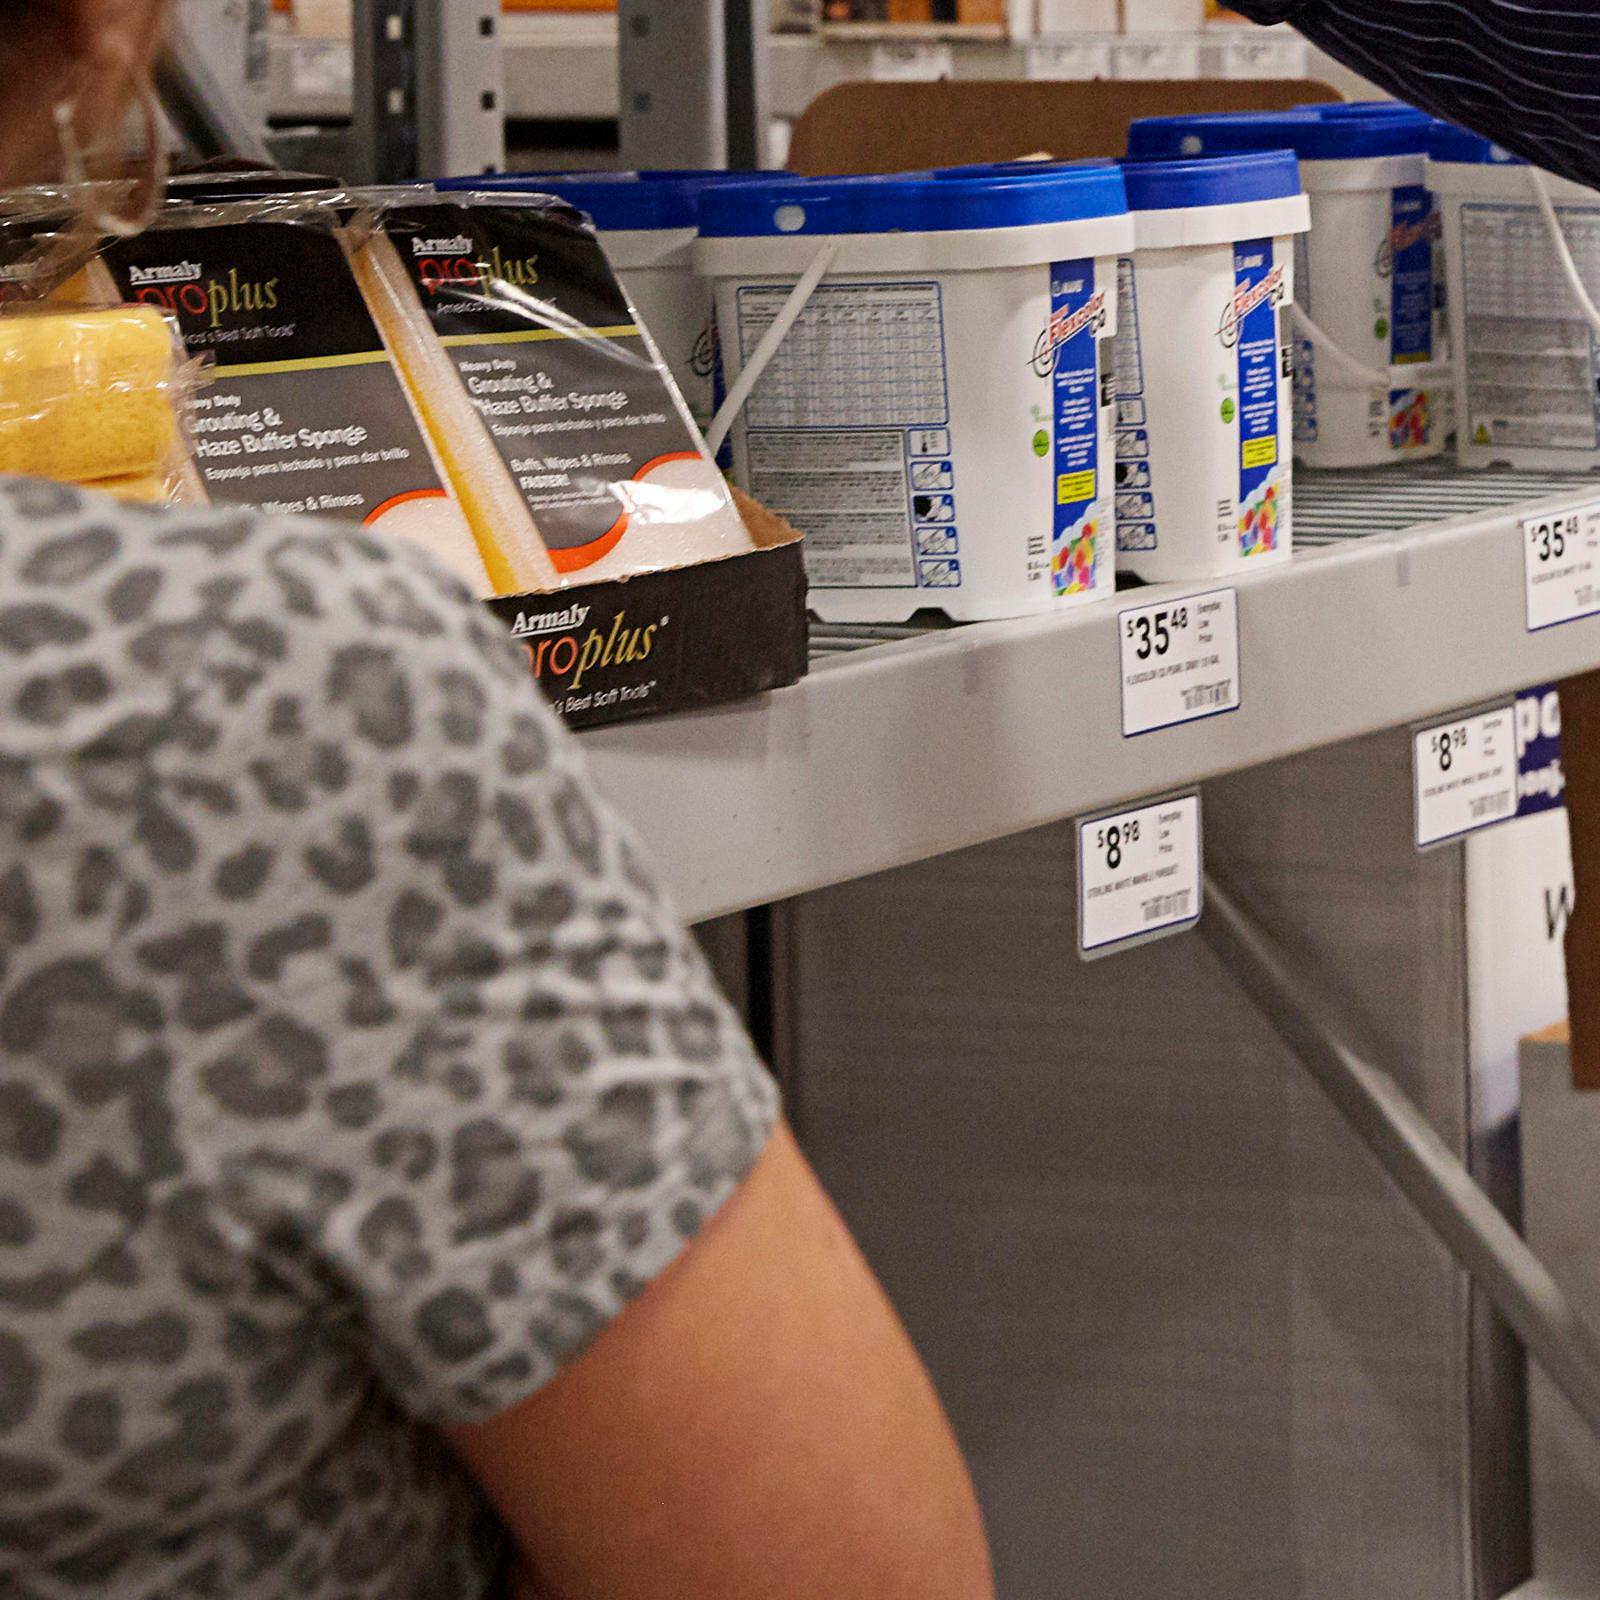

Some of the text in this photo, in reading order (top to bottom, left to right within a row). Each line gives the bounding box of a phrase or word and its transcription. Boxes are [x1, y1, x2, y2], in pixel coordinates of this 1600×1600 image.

[129, 260, 202, 285] Armaly
[519, 394, 569, 414] Buffer
[568, 390, 629, 412] Sponge
[193, 425, 368, 458] Haze Buffer Sponge
[511, 603, 591, 638] Armaly
[522, 610, 658, 690] roplus
